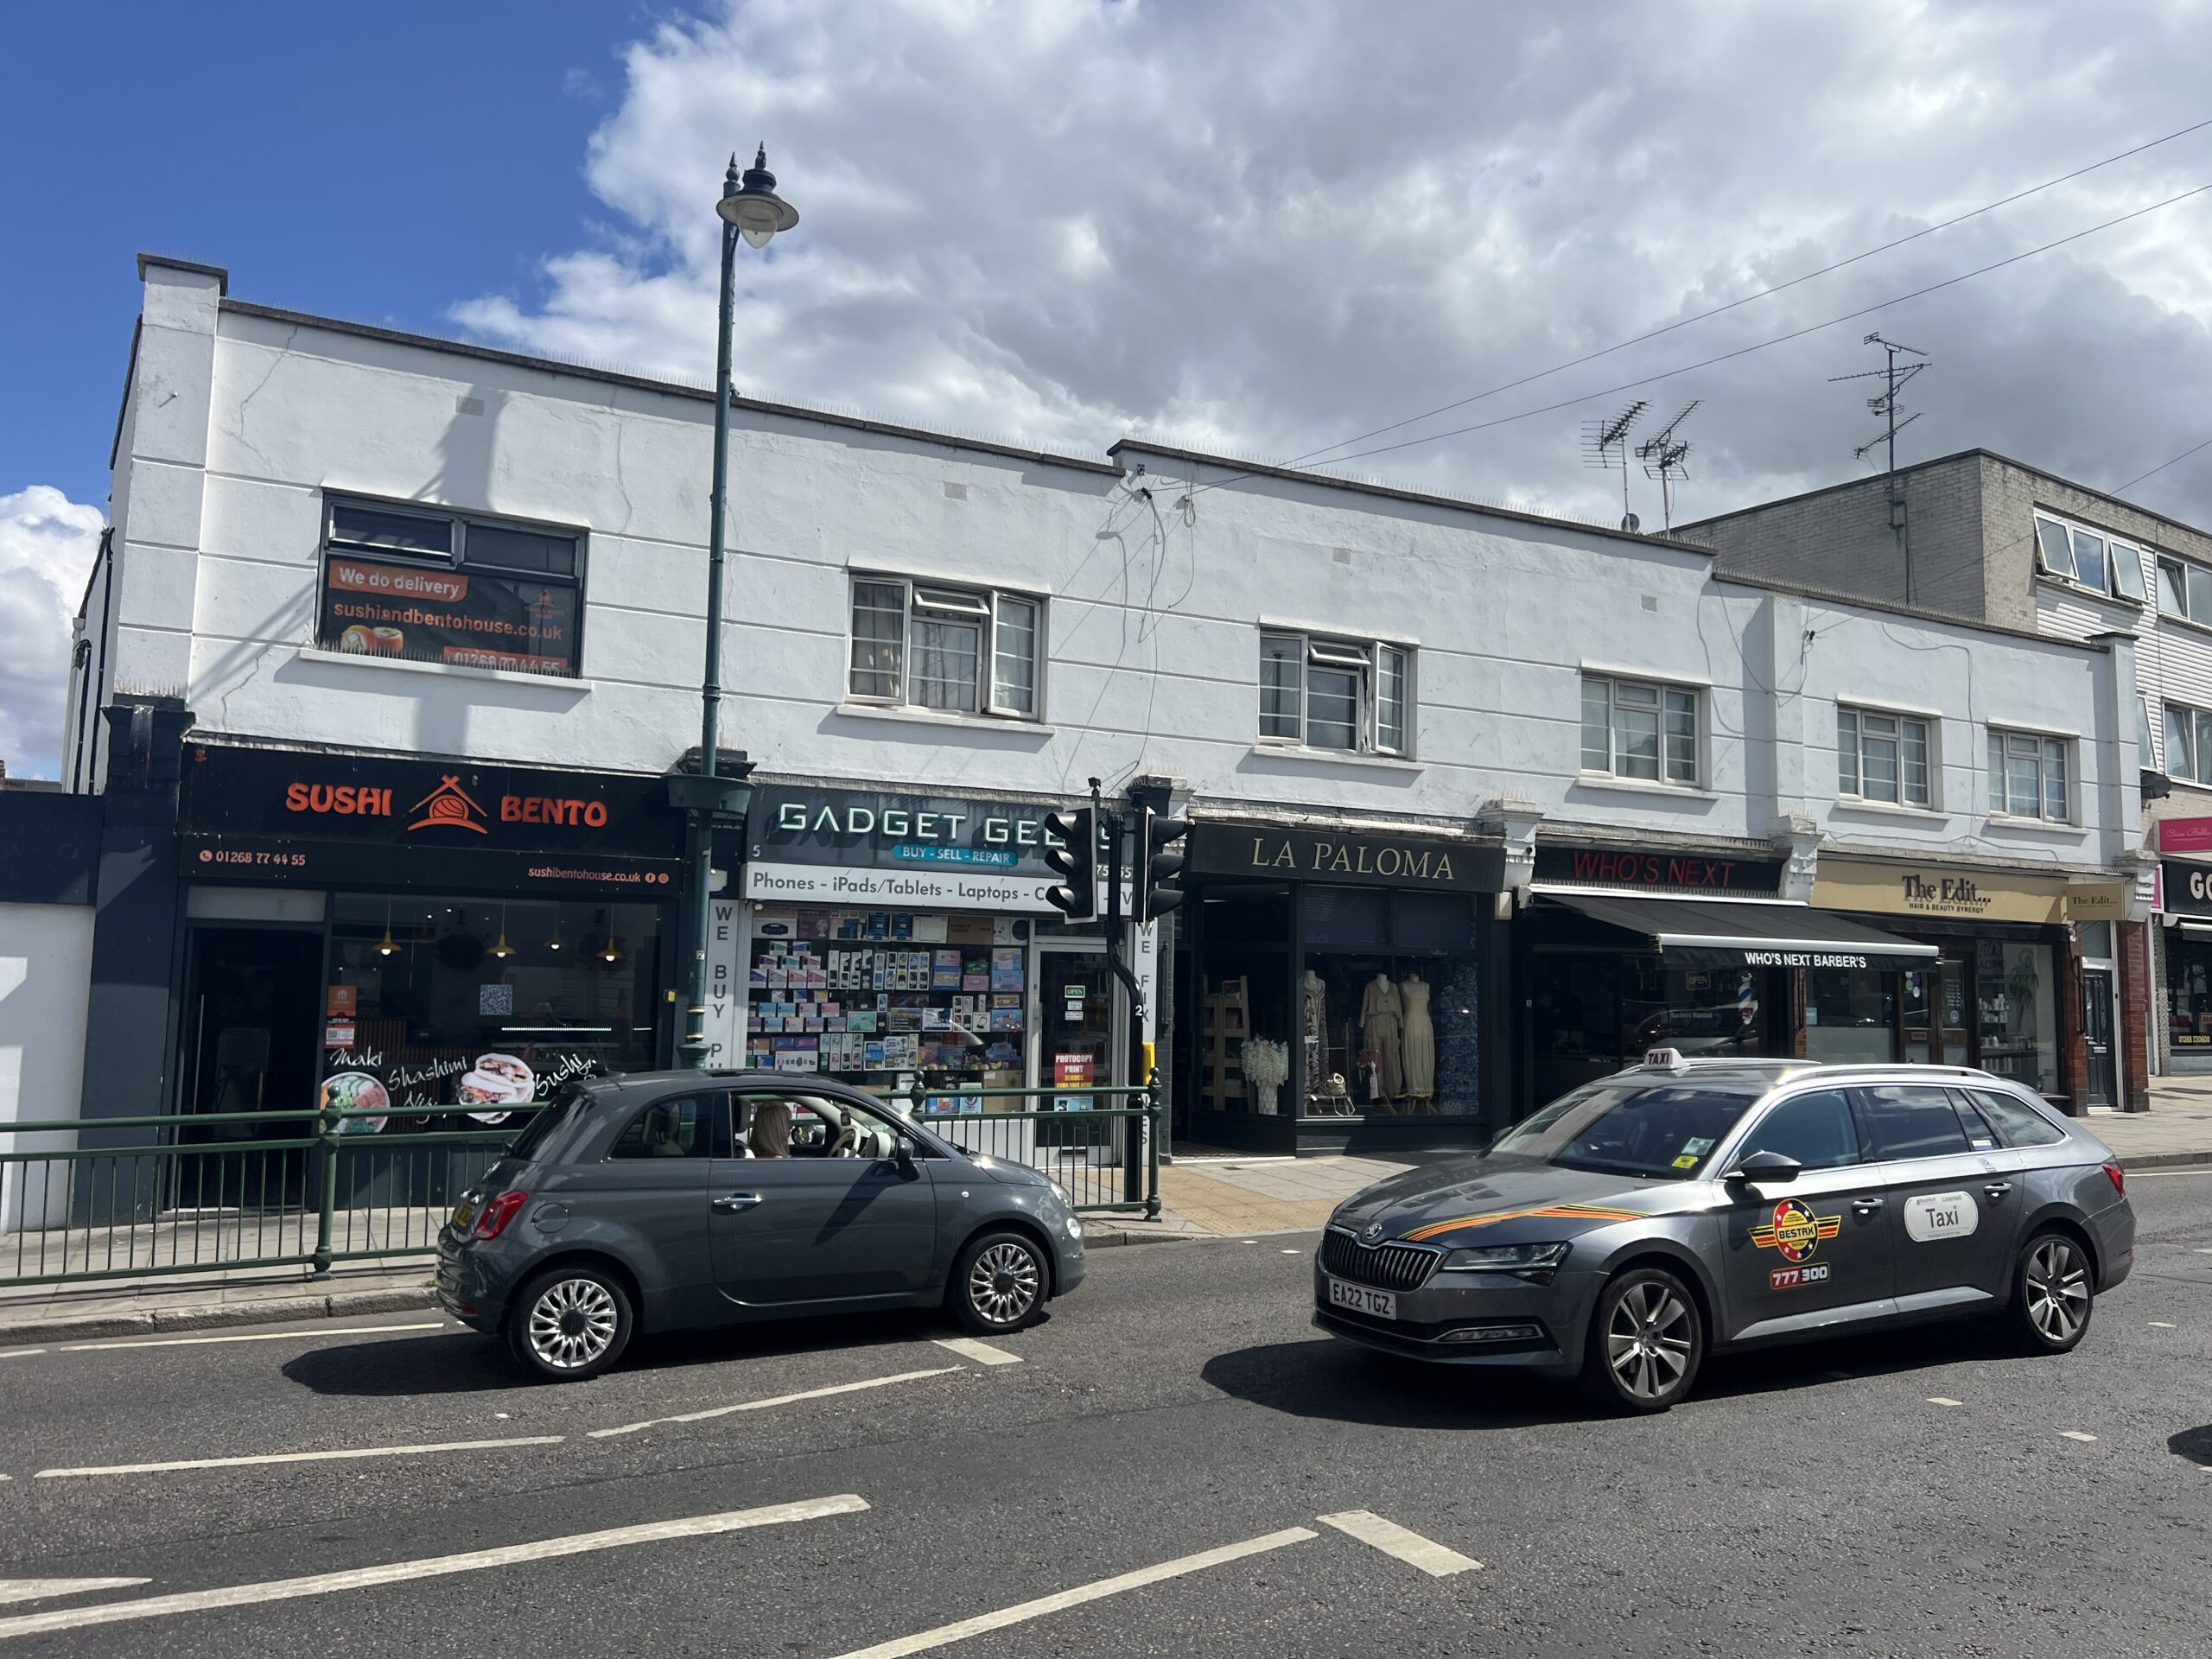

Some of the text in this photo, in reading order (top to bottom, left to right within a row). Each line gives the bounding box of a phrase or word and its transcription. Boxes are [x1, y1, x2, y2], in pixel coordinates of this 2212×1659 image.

[340, 567, 459, 599] We do delivery
[334, 603, 563, 640] sushiandbentohouse.co.uk
[286, 783, 607, 828] SUSHI BENTO
[779, 803, 966, 842] GADGET
[216, 851, 306, 866] 01268 77 44 55
[752, 844, 761, 857] 5
[903, 846, 926, 858] BUY
[938, 848, 962, 860] SELL
[973, 850, 1011, 863] REPAIR
[1251, 837, 1455, 880] LA PALOMA
[528, 867, 640, 883] sushibentohouse.co.uk
[1574, 851, 1735, 888] WHO'S NEXT
[753, 872, 815, 890] Phones
[833, 876, 942, 896] iPads/Tablets
[958, 882, 1019, 902] Laptops
[1902, 874, 1991, 903] The Edit...
[2190, 871, 2212, 902] G
[2071, 896, 2088, 905] The
[713, 906, 733, 1019] WE BUY
[1745, 951, 1866, 968] WHO'S NEXT BARBER'S
[1135, 1004, 1143, 1017] 2
[330, 1046, 383, 1068] Maki
[1055, 1054, 1092, 1064] PHOTOCOPY
[1065, 1065, 1084, 1073] PRINT
[1648, 1052, 1670, 1065] TAXI
[388, 1056, 467, 1091] Shashimi
[536, 1053, 582, 1096] Sushi
[1925, 1205, 1960, 1229] Taxi
[1779, 1226, 1814, 1239] BESTAX
[1772, 1266, 1827, 1286] 777 300
[1333, 1283, 1390, 1315] EA22 TGZ
